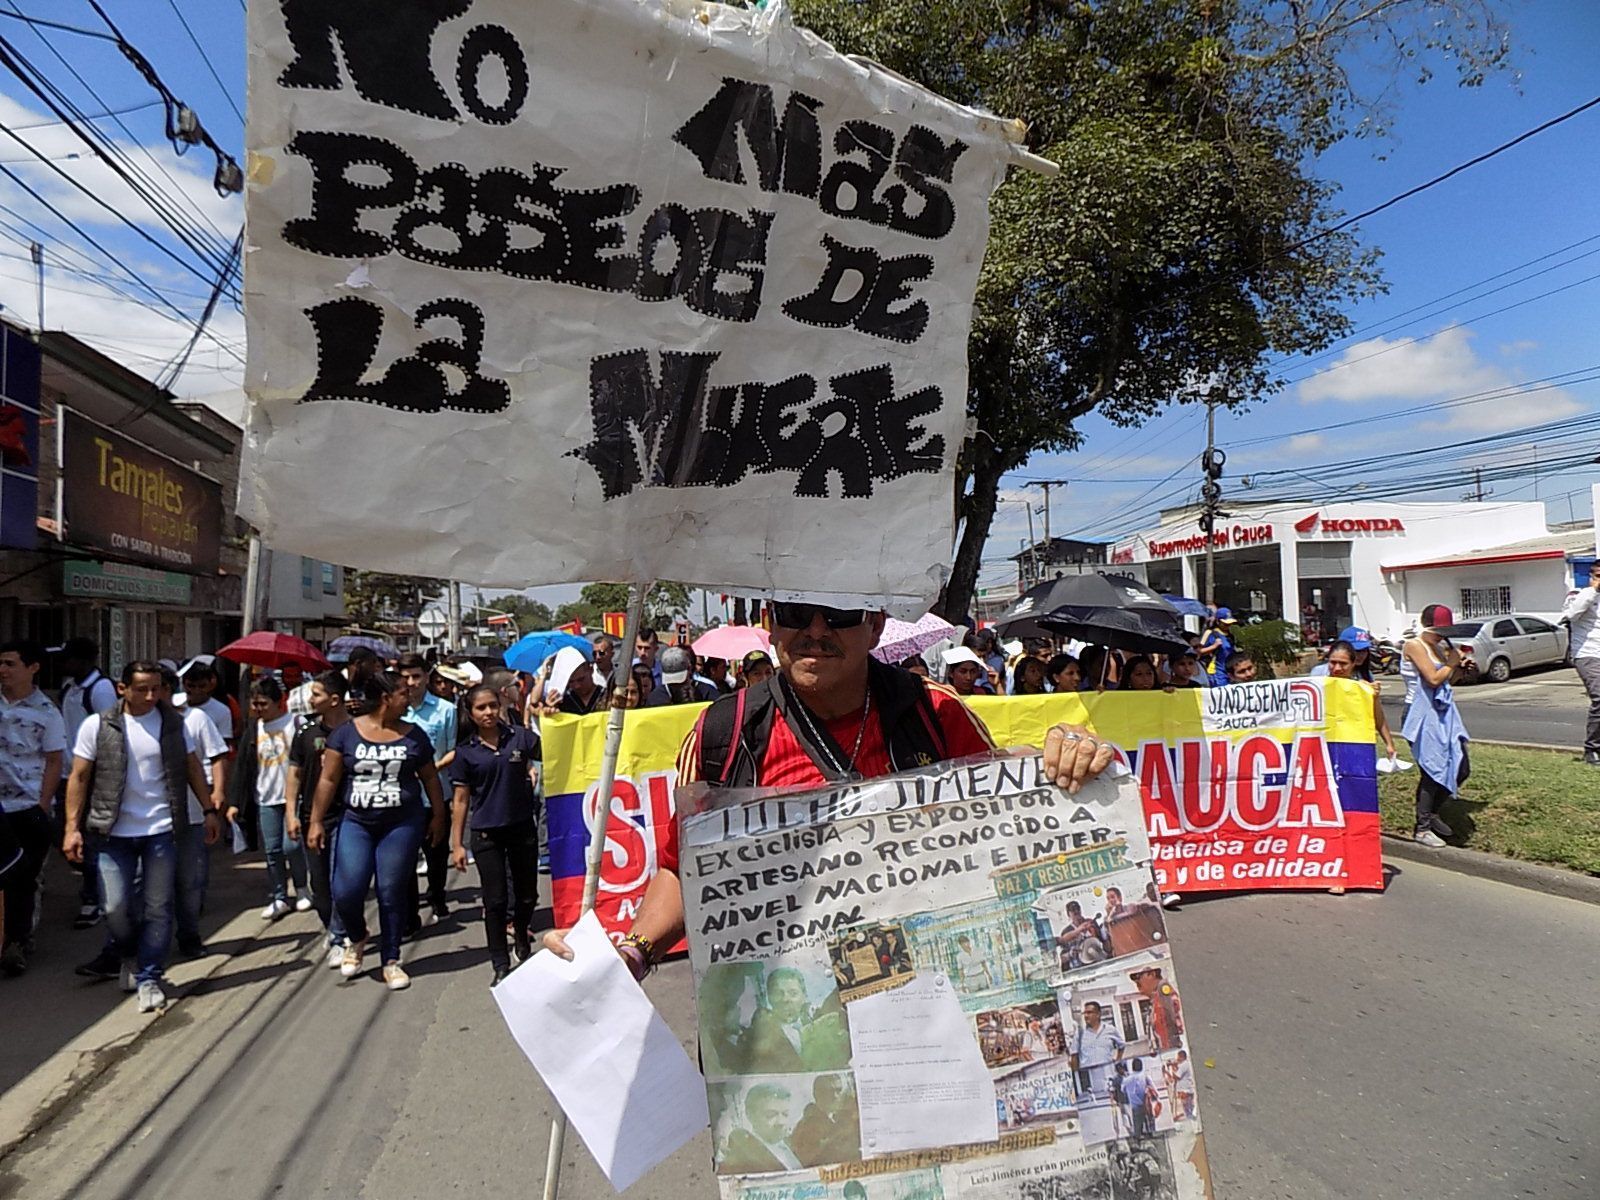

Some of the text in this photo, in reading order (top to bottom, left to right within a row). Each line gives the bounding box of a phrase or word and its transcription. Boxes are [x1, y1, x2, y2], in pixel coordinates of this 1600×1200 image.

[781, 234, 935, 343] DE
[95, 437, 184, 515] Tamales
[1233, 523, 1273, 544] Cauca
[1322, 518, 1405, 534] HONDA
[111, 533, 128, 548] CON
[1209, 682, 1289, 714] SINDESENA
[886, 755, 1057, 811] JIMENE
[1112, 733, 1345, 836] AUCA
[350, 791, 402, 808] OVER
[700, 851, 862, 904] ARTESANO
[1070, 806, 1096, 824] A
[991, 847, 1009, 866] E
[1248, 836, 1286, 854] de
[1297, 835, 1325, 853] la
[1039, 862, 1093, 886] RESPETO
[1176, 866, 1188, 885] y
[1196, 860, 1224, 880] de
[1232, 858, 1348, 878] calidad.
[970, 1174, 990, 1186] Luis
[1060, 1151, 1107, 1171] prospecto
